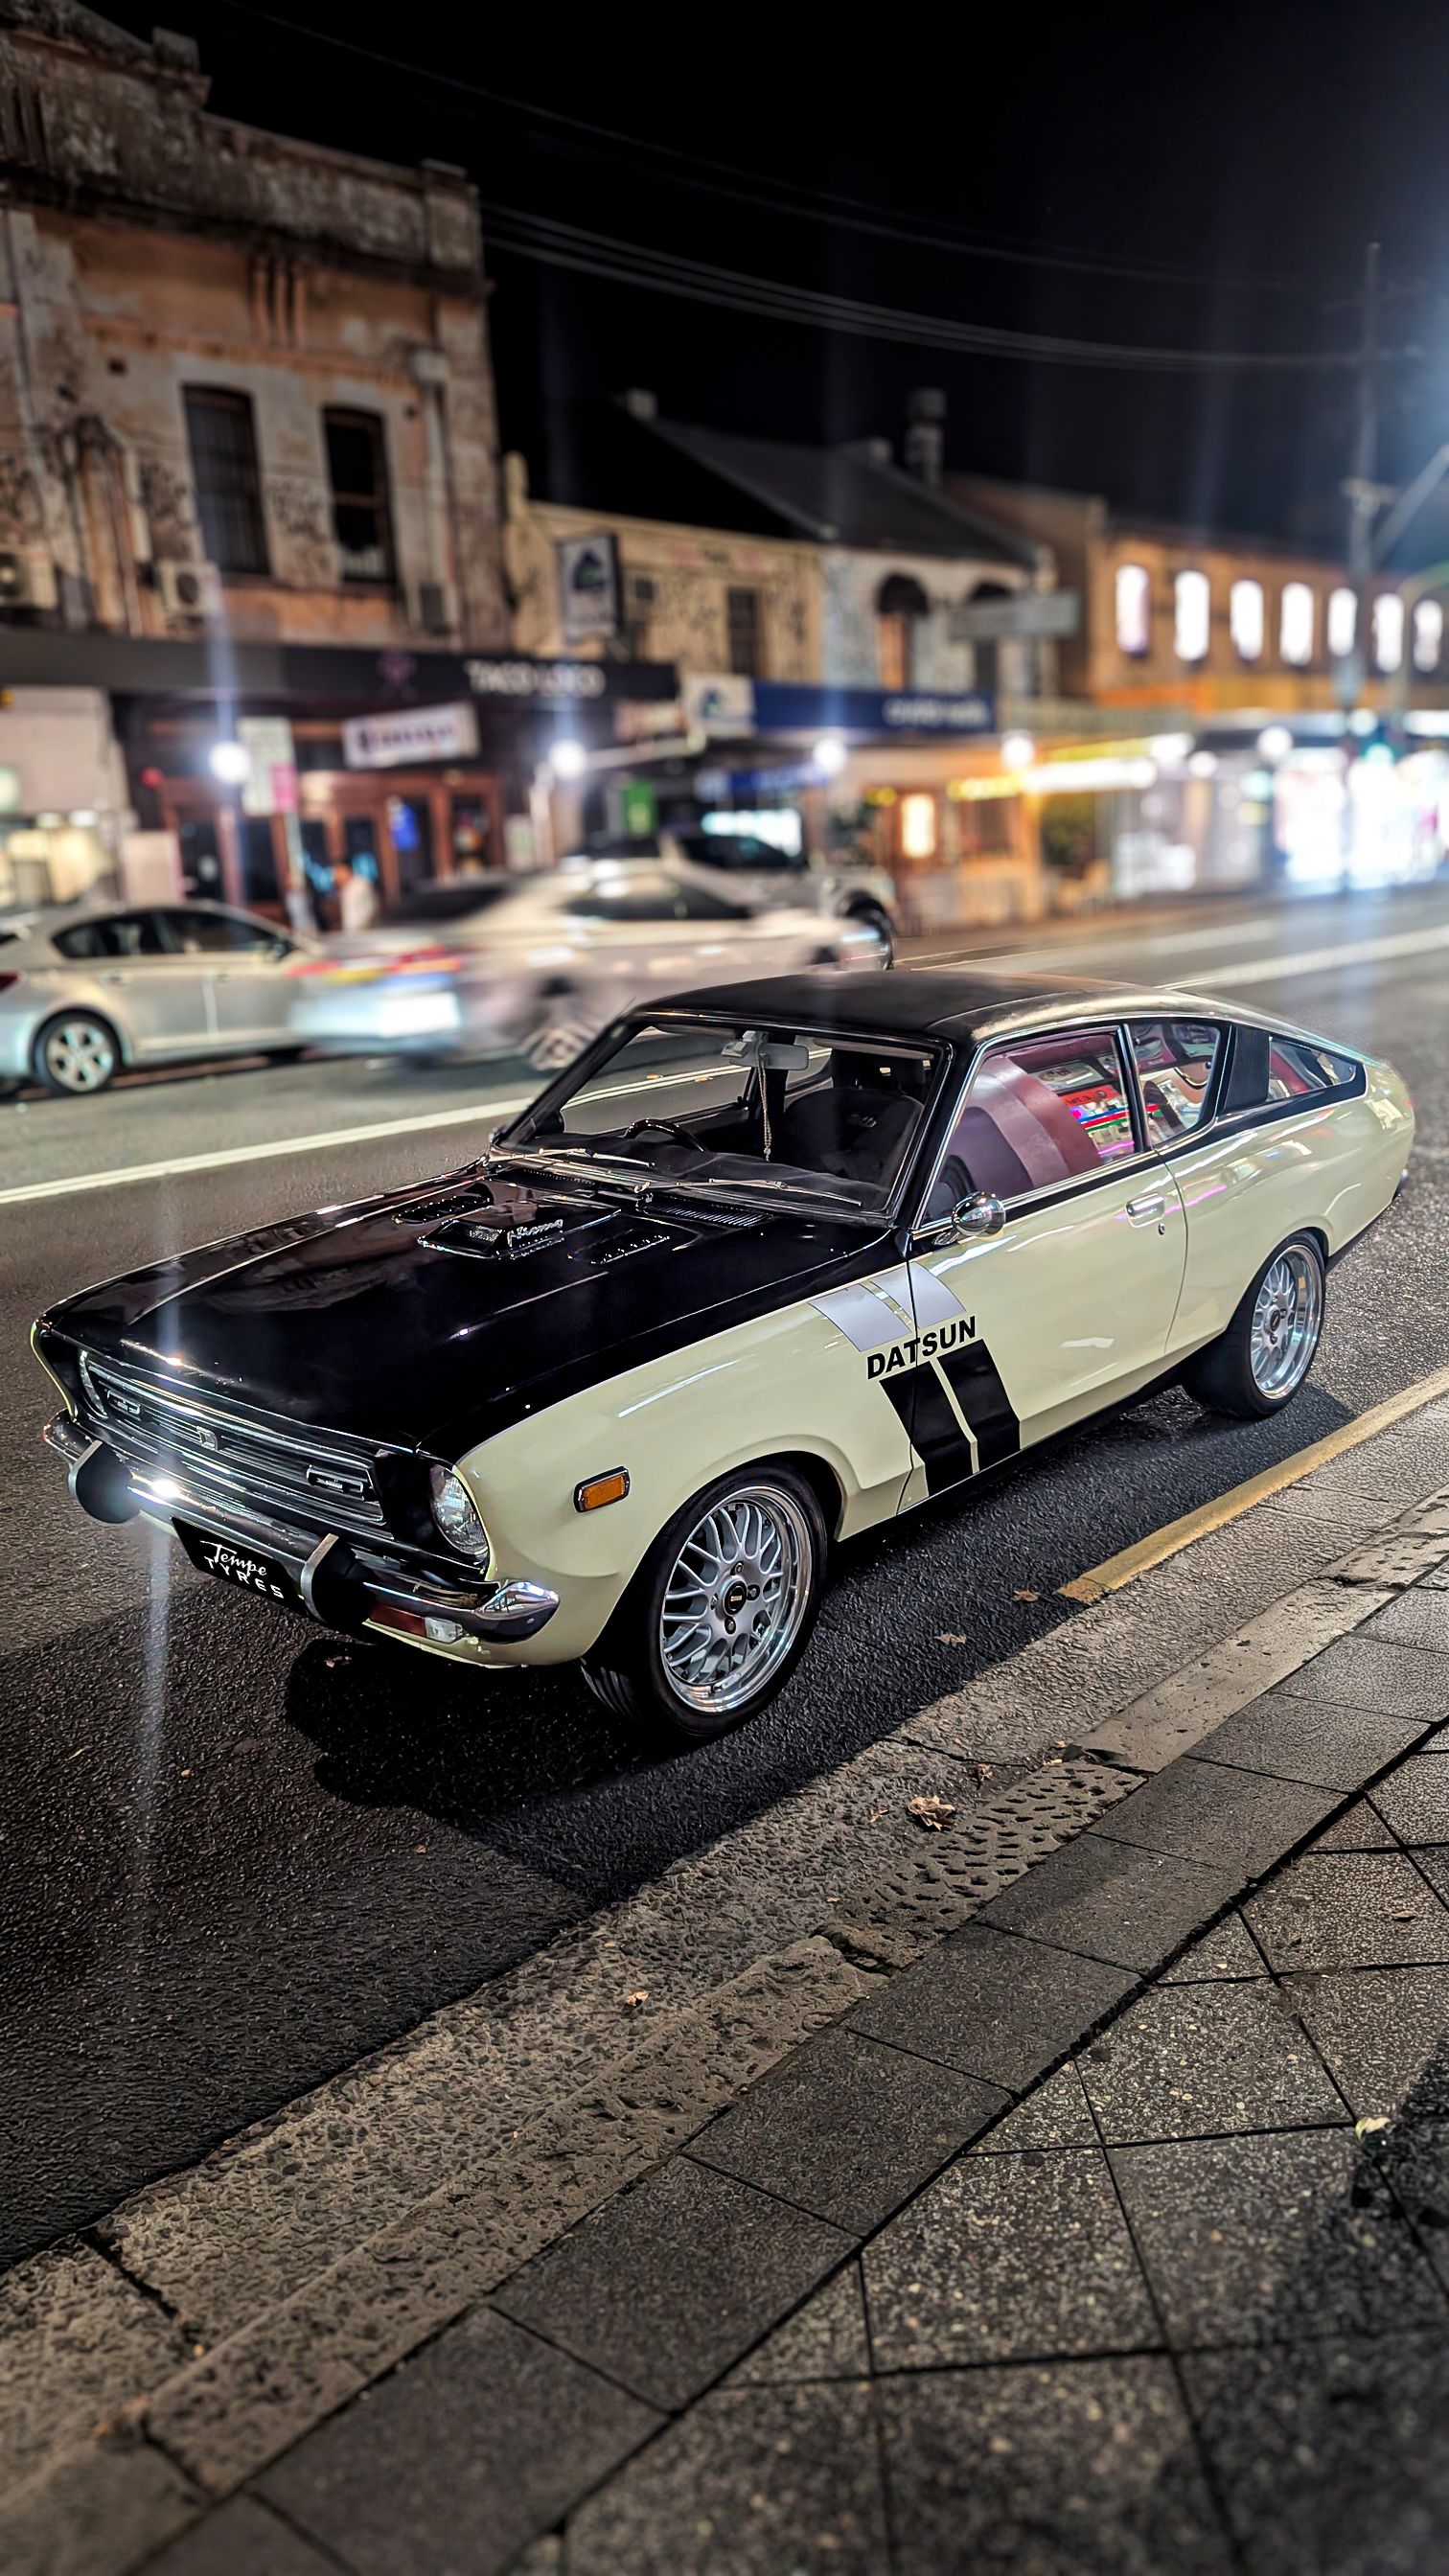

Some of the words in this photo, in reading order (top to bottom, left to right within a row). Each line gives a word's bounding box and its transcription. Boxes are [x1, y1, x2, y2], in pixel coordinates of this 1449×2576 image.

[465, 660, 533, 696] TACO
[867, 1315, 976, 1380] DATSUN
[199, 1540, 267, 1576] Tempe
[204, 1556, 285, 1598] TYRES
